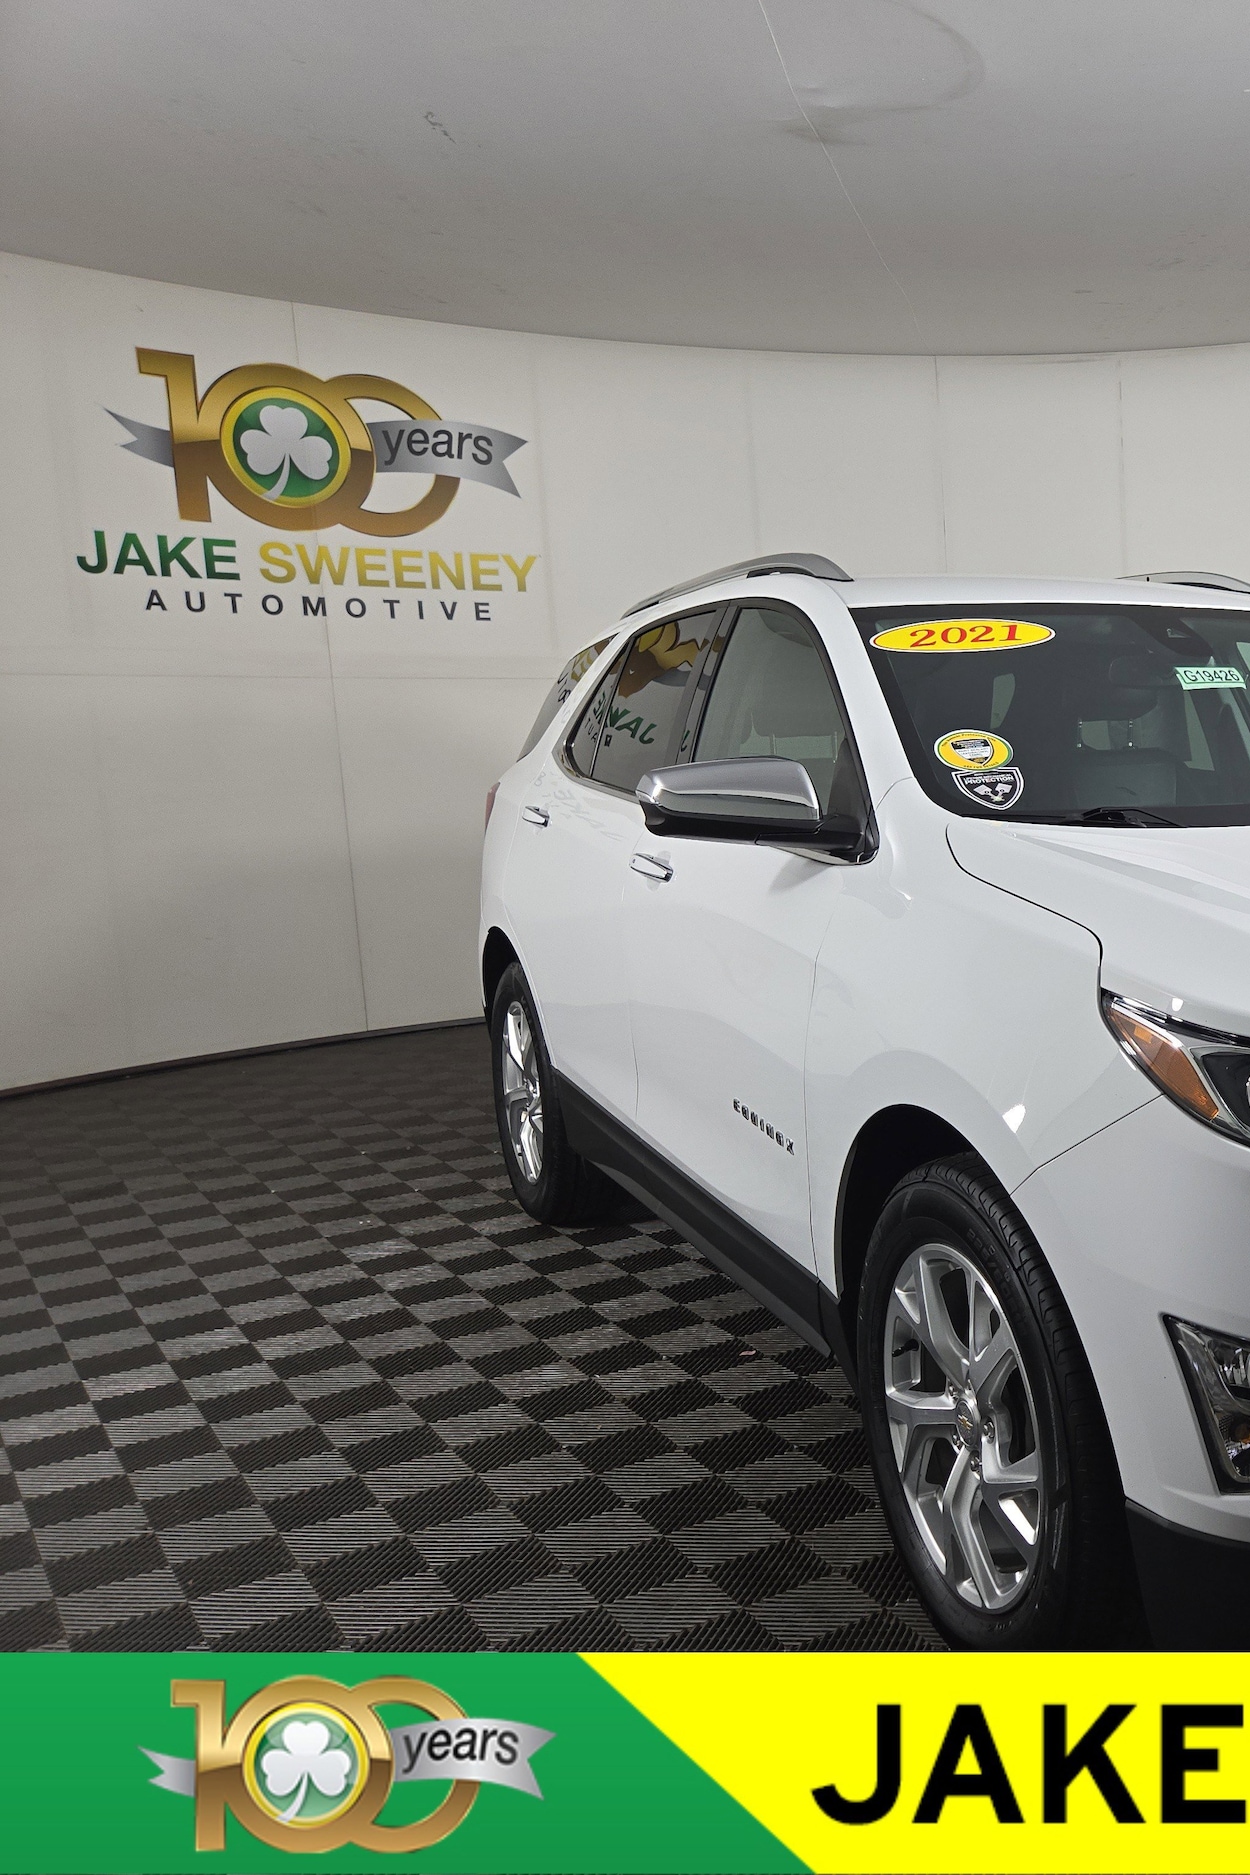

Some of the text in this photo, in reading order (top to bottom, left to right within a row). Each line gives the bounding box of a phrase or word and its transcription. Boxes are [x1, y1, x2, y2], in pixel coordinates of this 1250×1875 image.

[135, 346, 494, 537] 100 years
[76, 529, 536, 592] JAKE SWEENEY
[145, 588, 492, 622] AUTOMOTIVE
[909, 624, 1021, 648] 2021
[1183, 670, 1240, 682] G19426
[732, 1098, 795, 1156] EQUINOX
